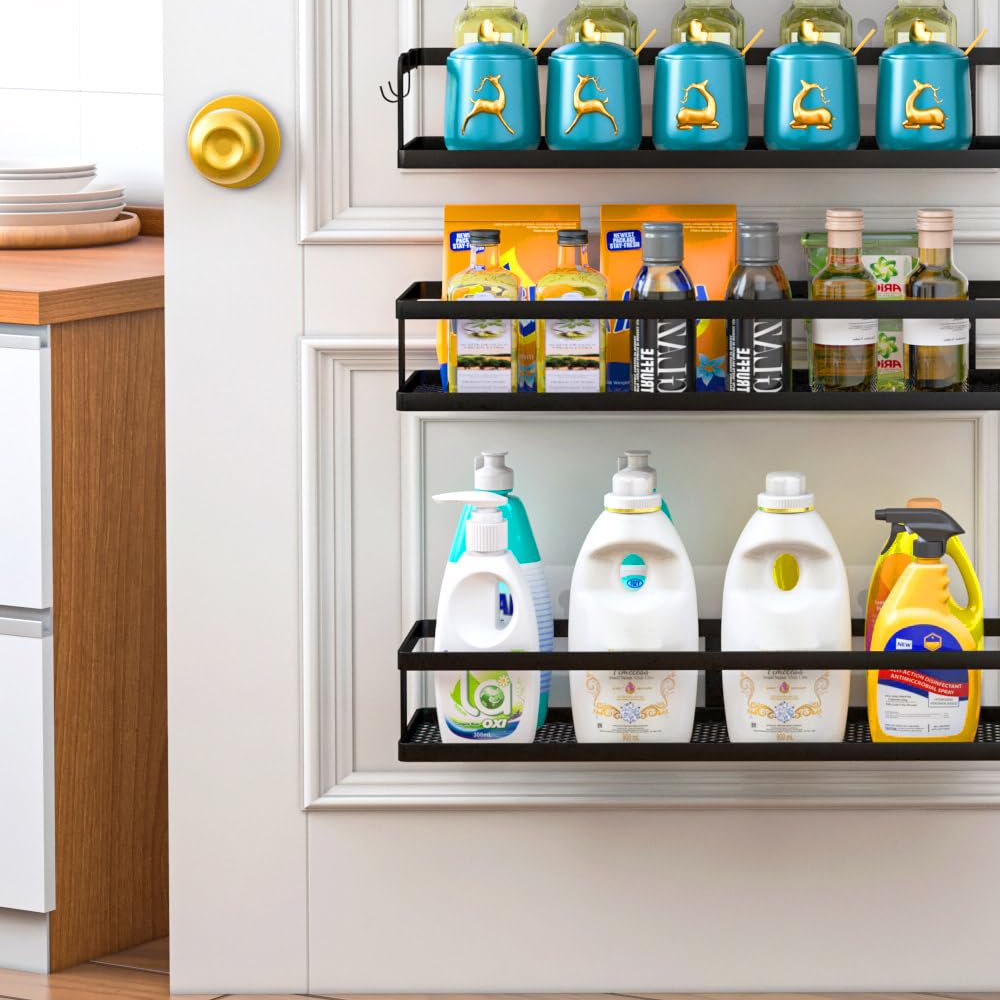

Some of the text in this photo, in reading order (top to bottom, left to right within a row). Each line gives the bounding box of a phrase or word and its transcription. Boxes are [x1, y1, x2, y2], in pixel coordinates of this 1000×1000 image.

[902, 669, 925, 679] ACTION
[924, 676, 962, 689] DISINFECTANT
[937, 687, 955, 695] SPRAY
